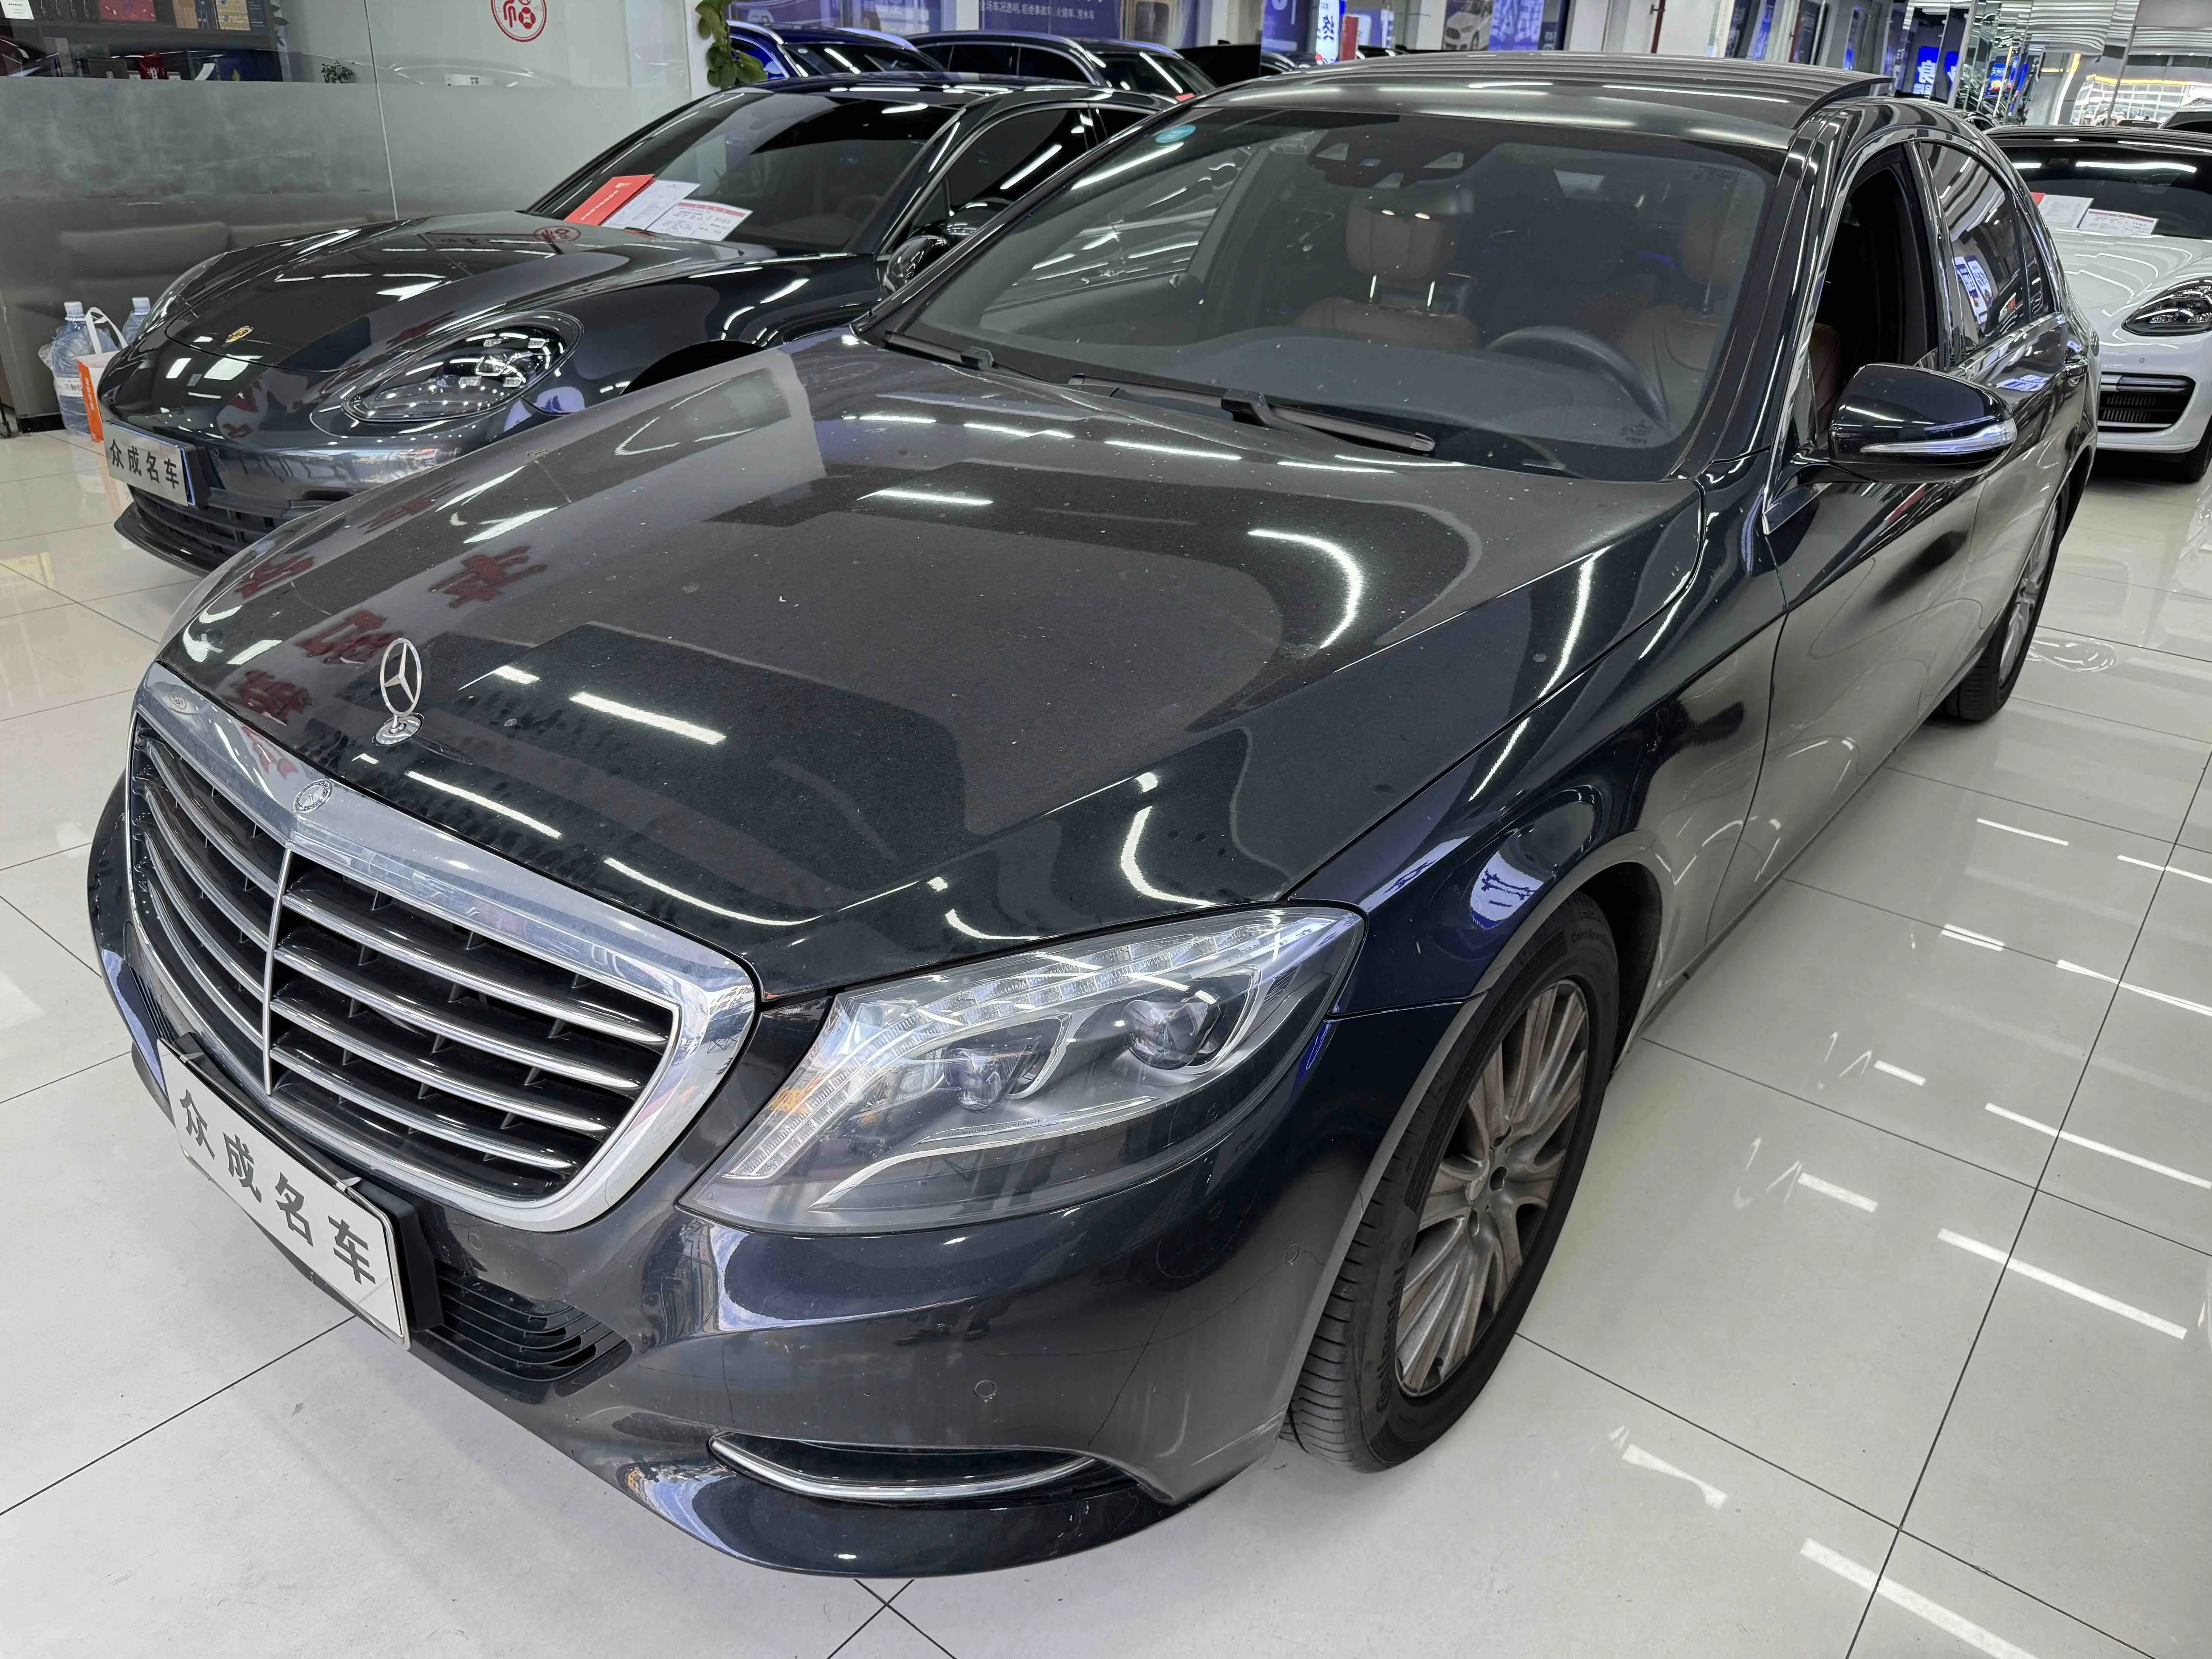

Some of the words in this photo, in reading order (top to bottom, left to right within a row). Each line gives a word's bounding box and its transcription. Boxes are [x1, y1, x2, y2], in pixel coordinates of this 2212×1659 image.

[110, 439, 179, 489] 众成名车
[179, 1089, 376, 1285] 众成名车
